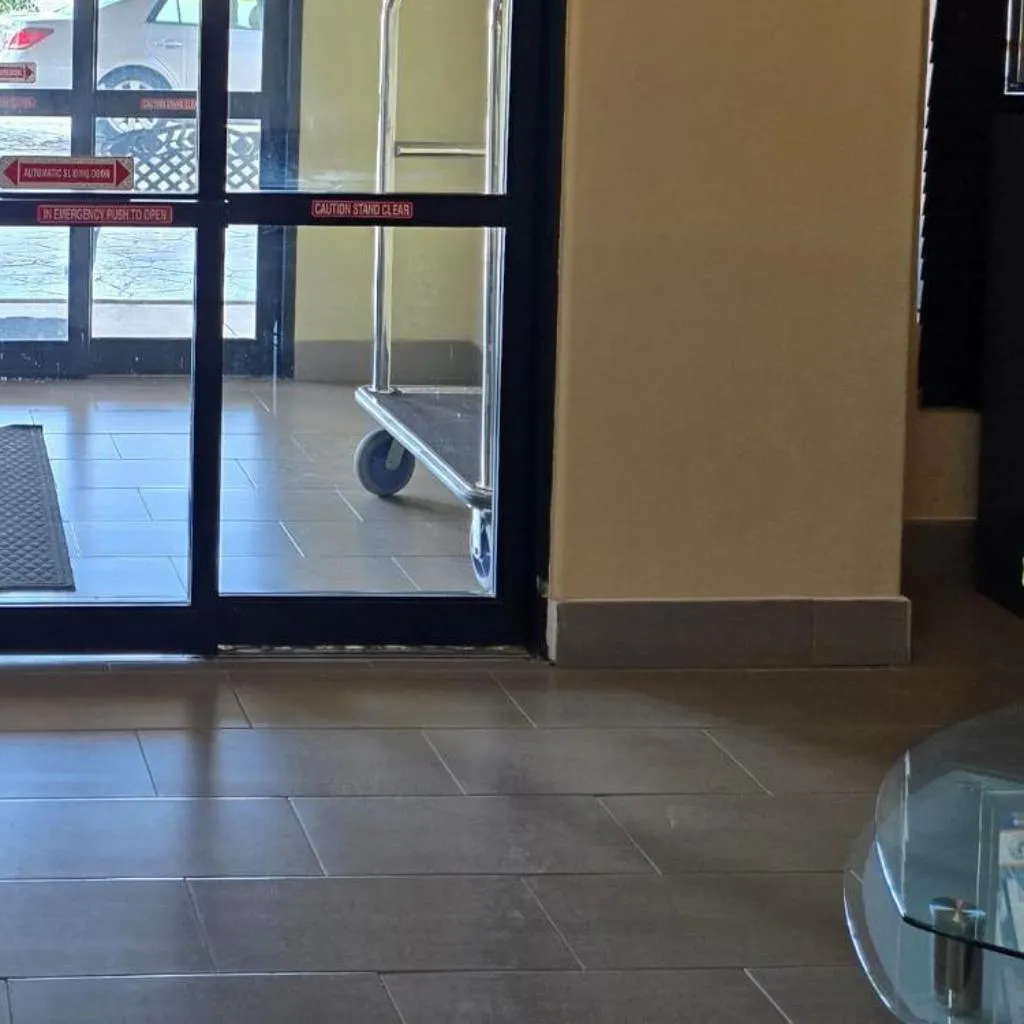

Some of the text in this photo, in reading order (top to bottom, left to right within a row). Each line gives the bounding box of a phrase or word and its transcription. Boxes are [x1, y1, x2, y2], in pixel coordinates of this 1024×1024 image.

[23, 167, 62, 178] AUTOMATIC
[43, 207, 167, 221] IN EMERGENCY PUSH TO OPEN
[315, 202, 409, 216] CAUTION STAND CLEAR
